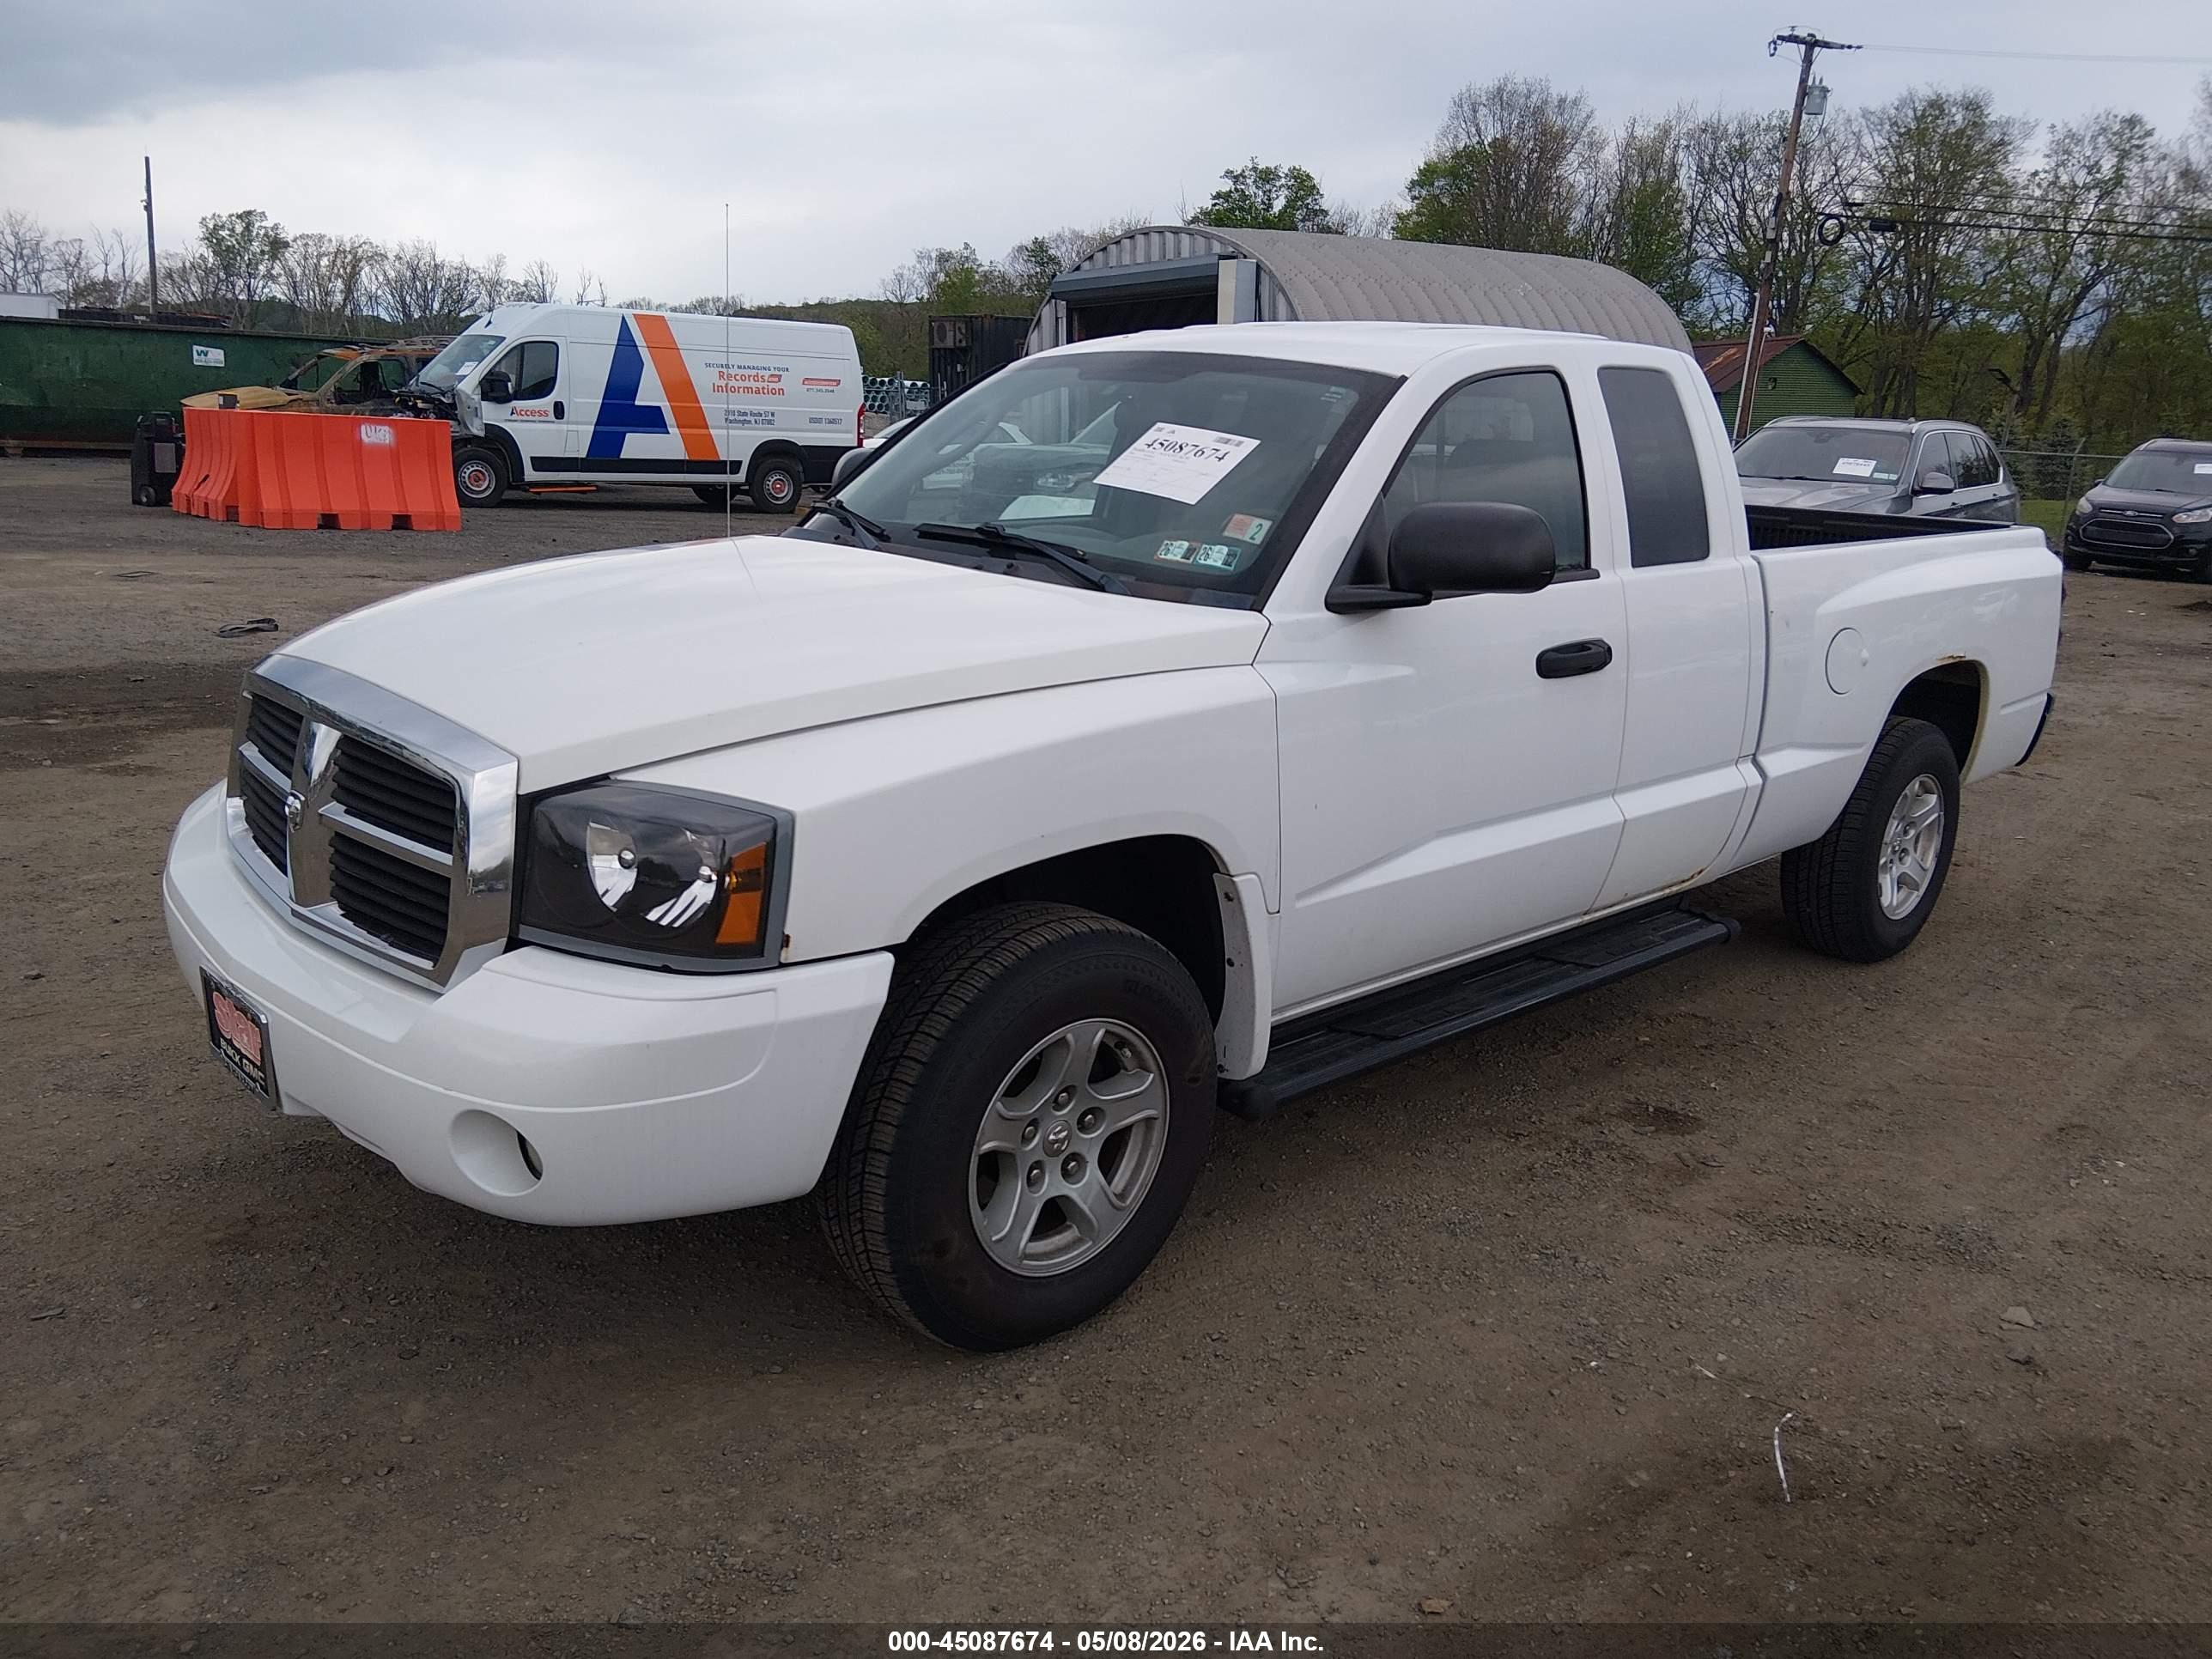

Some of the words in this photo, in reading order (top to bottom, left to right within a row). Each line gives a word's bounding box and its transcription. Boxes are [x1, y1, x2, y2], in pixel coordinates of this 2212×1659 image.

[718, 371, 766, 383] Records
[712, 383, 785, 396] Information
[510, 406, 550, 417] Access
[1144, 438, 1231, 462] 45087674
[1249, 523, 1264, 541] 2
[220, 1037, 241, 1066] BUICK
[242, 1057, 266, 1087] GMC
